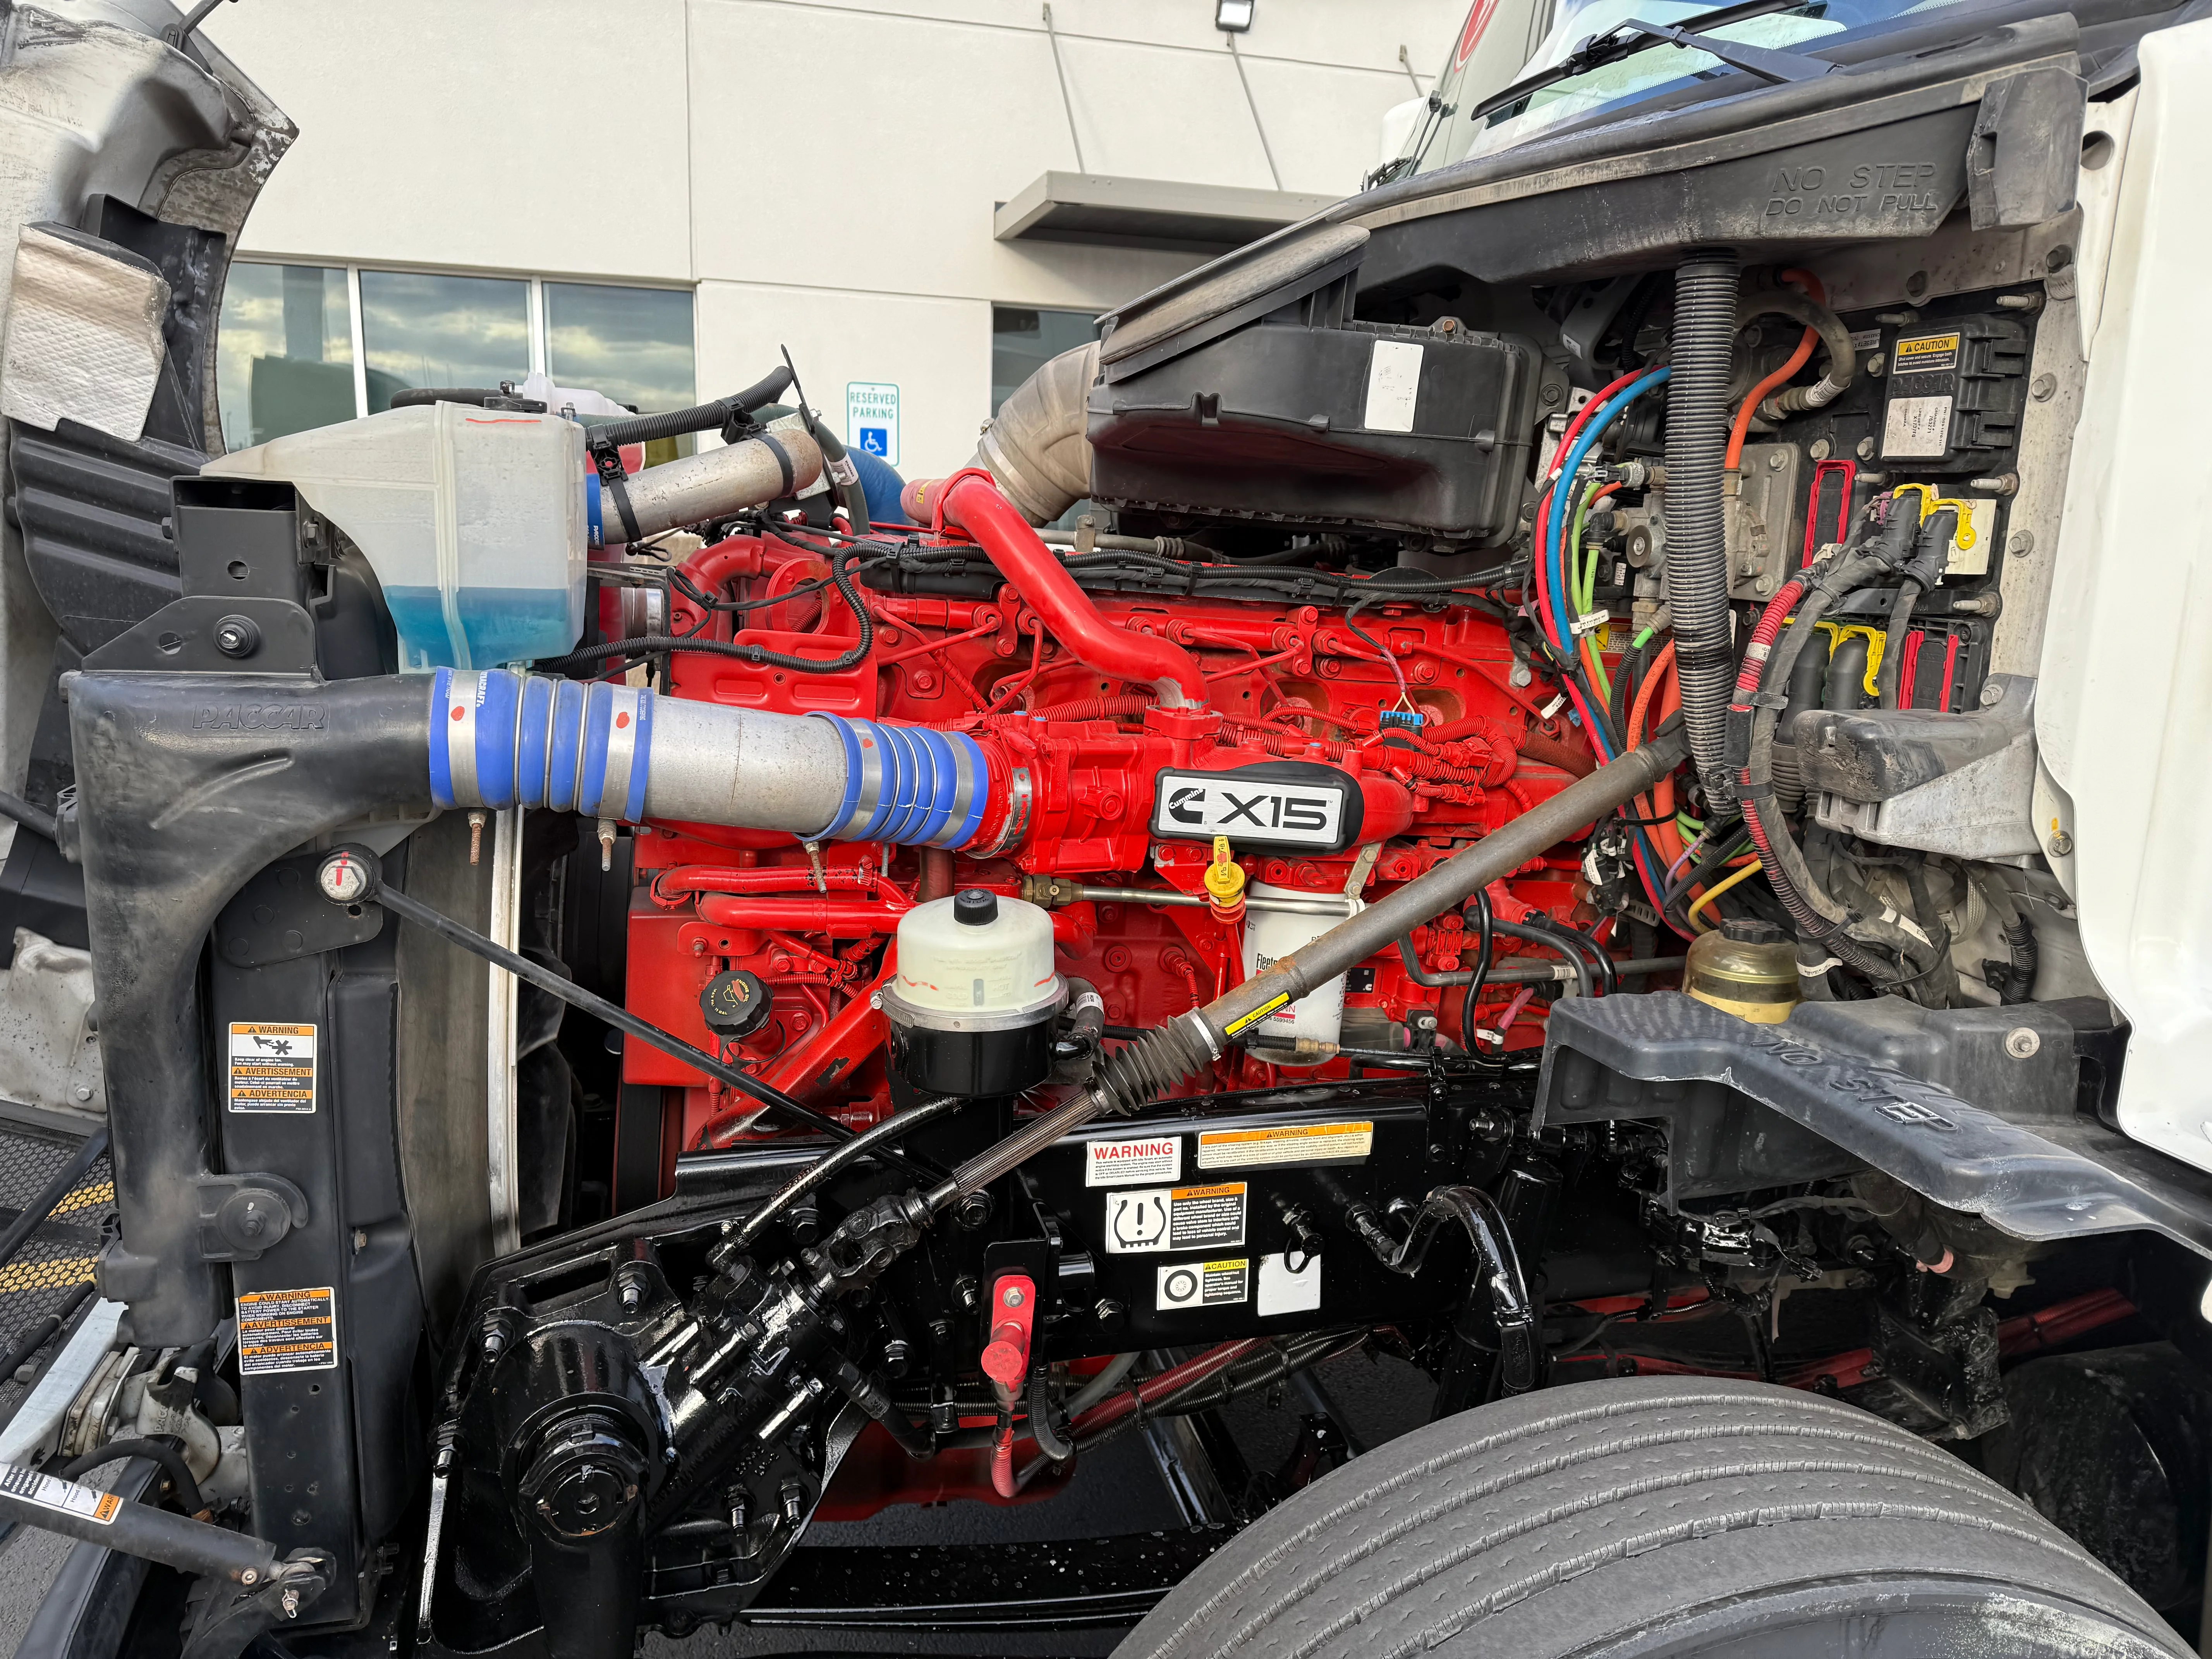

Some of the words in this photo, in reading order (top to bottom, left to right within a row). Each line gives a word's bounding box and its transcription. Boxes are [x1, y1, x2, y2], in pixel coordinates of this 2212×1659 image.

[1773, 167, 1826, 192] NO
[1850, 163, 1936, 189] STEP
[1765, 197, 1803, 216] DO
[1817, 194, 1868, 213] NOT
[1879, 191, 1937, 211] PULL
[1915, 339, 1949, 351] CAUTION
[1889, 374, 1954, 395] PACCAR
[850, 392, 896, 405] RESERVED
[853, 407, 894, 419] PARKING
[192, 704, 325, 730] PACCAR
[1169, 788, 1204, 809] Cummins
[1216, 792, 1327, 830] X15
[735, 979, 749, 993] ENGINE
[1252, 1005, 1271, 1018] CAUTION
[246, 1067, 311, 1076] AVERTISSEMENT
[249, 1089, 307, 1097] ADVERTENCIA
[1272, 1129, 1308, 1137] WARNING
[1094, 1142, 1173, 1159] WARNING
[1194, 1187, 1230, 1196] WARNING
[1212, 1260, 1246, 1270] CAUTION
[266, 1291, 311, 1300] WARNING
[252, 1317, 328, 1328] AVERTISSEMENT
[260, 1343, 325, 1353] ADVERTENCIA
[11, 1474, 24, 1492] ensure
[19, 1473, 33, 1494] engaged
[41, 1479, 50, 1491] Hood
[70, 1489, 80, 1503] Hood
